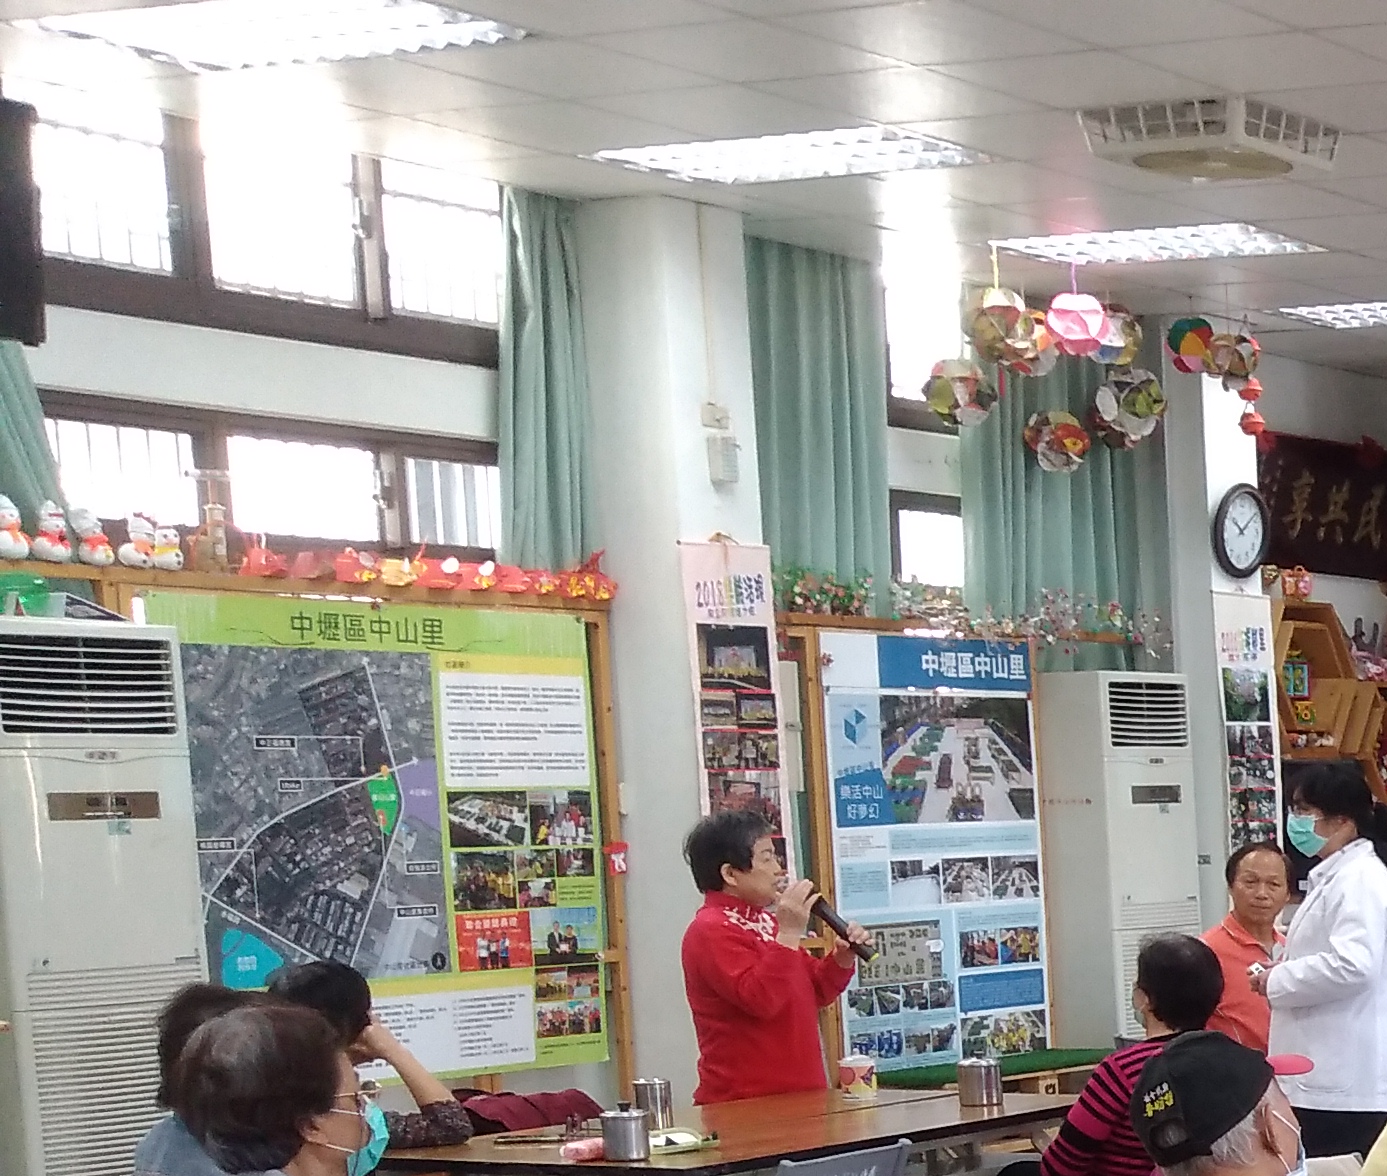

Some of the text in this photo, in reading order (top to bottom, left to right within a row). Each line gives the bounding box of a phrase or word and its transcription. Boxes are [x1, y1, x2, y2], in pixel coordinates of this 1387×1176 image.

[290, 610, 445, 645] 中壢區中山里
[921, 649, 1027, 680] 中壢區中山里
